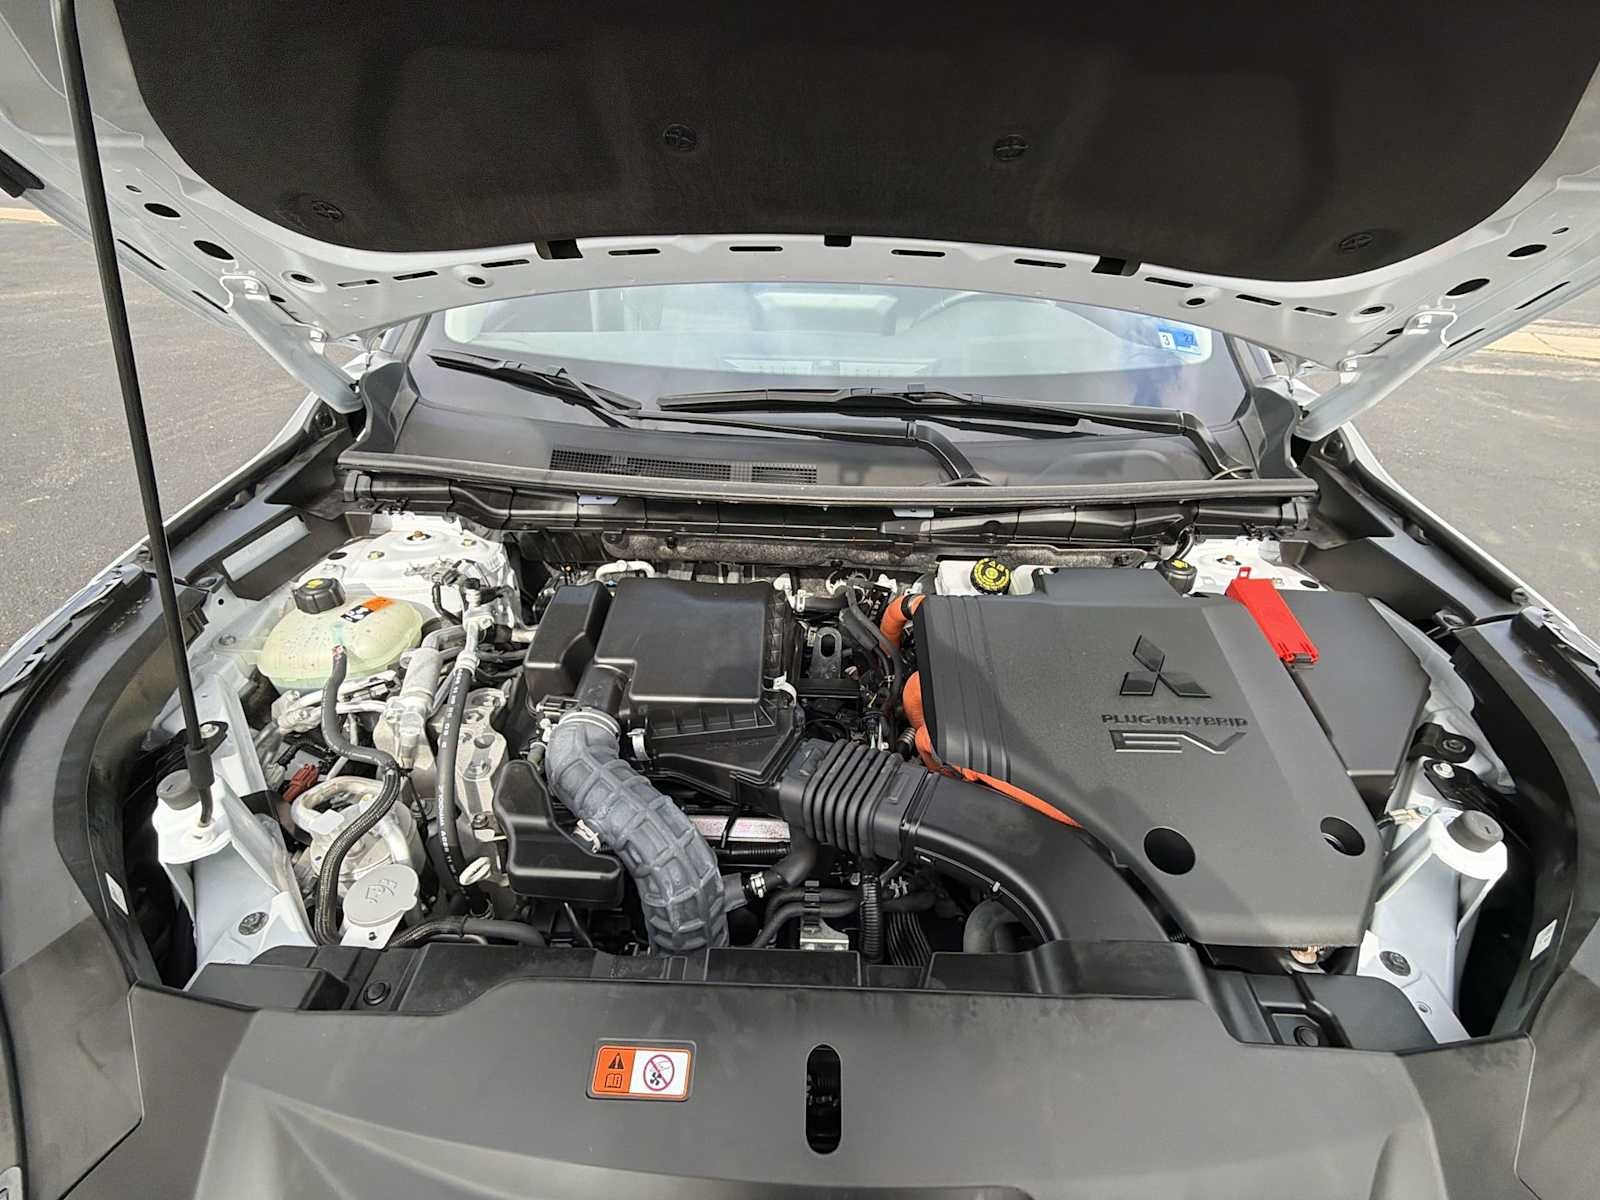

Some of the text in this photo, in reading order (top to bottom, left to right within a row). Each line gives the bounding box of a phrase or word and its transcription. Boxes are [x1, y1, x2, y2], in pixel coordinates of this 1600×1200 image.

[1162, 334, 1171, 346] 3
[1101, 714, 1249, 727] PLUG-IN HYBRID
[1109, 729, 1247, 754] EV
